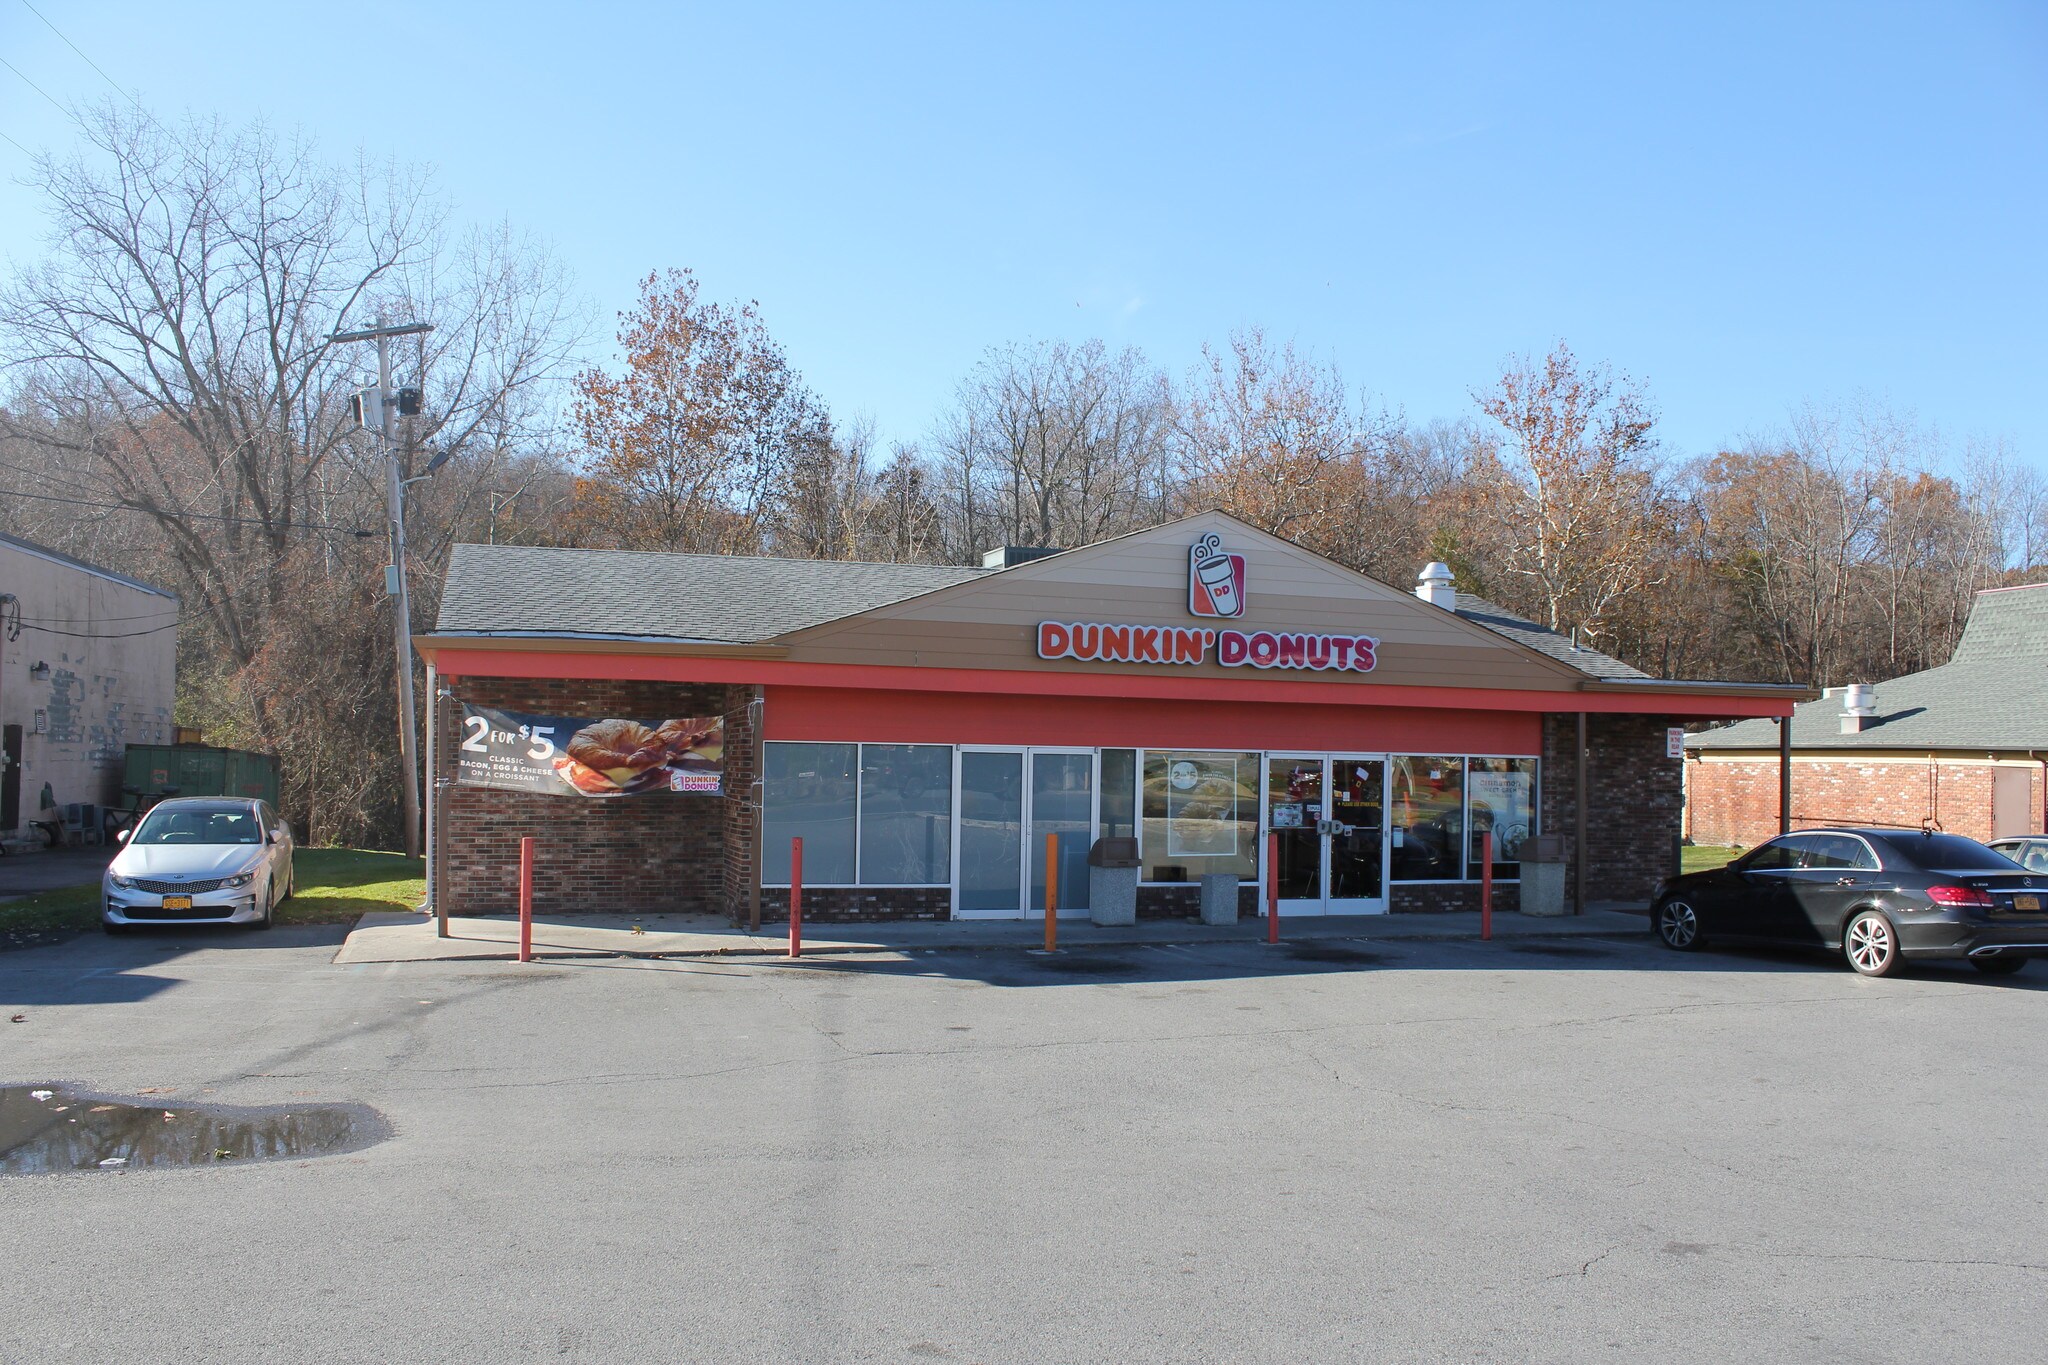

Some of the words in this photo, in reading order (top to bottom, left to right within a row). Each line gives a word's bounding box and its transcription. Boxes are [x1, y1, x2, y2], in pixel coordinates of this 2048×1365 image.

[1213, 584, 1230, 598] DD
[1041, 623, 1215, 663] DUNKIN'
[1221, 631, 1375, 671] DONUTS
[462, 716, 489, 752] 2
[491, 730, 516, 744] FOR
[518, 724, 555, 760] $5
[489, 755, 524, 765] CLASSIC
[460, 760, 491, 770] BACON,
[493, 763, 511, 771] EGG
[521, 766, 553, 776] CHEESE
[494, 772, 540, 782] CROISSANT
